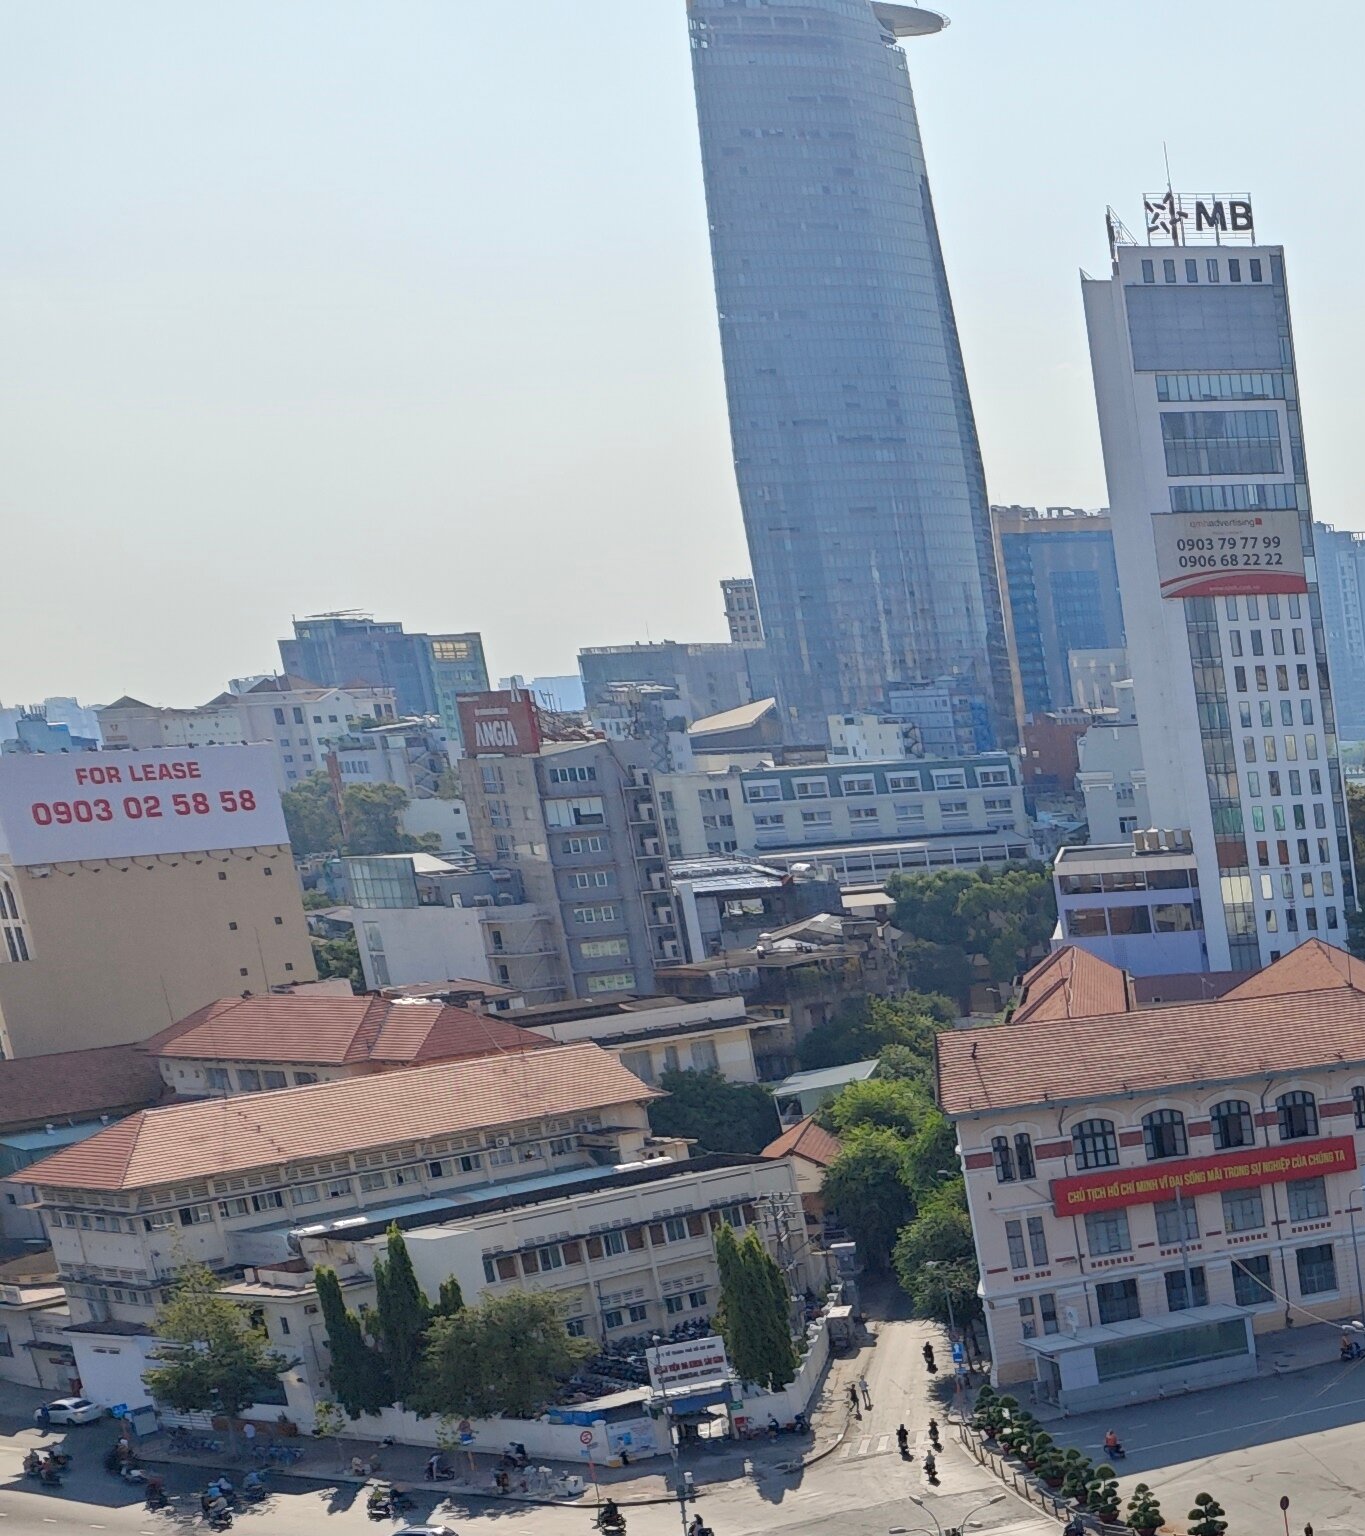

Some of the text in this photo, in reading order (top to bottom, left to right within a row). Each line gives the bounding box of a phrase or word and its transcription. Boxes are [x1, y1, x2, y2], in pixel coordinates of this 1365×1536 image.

[1195, 200, 1253, 231] MB
[1177, 536, 1281, 551] 0903 79 77 99
[1179, 553, 1283, 568] 0906 68 22 22
[75, 761, 202, 785] FOR LEASE
[31, 789, 257, 825] 0903 02 58 58
[1223, 1164, 1249, 1179] TRONG
[1335, 1149, 1346, 1161] TA
